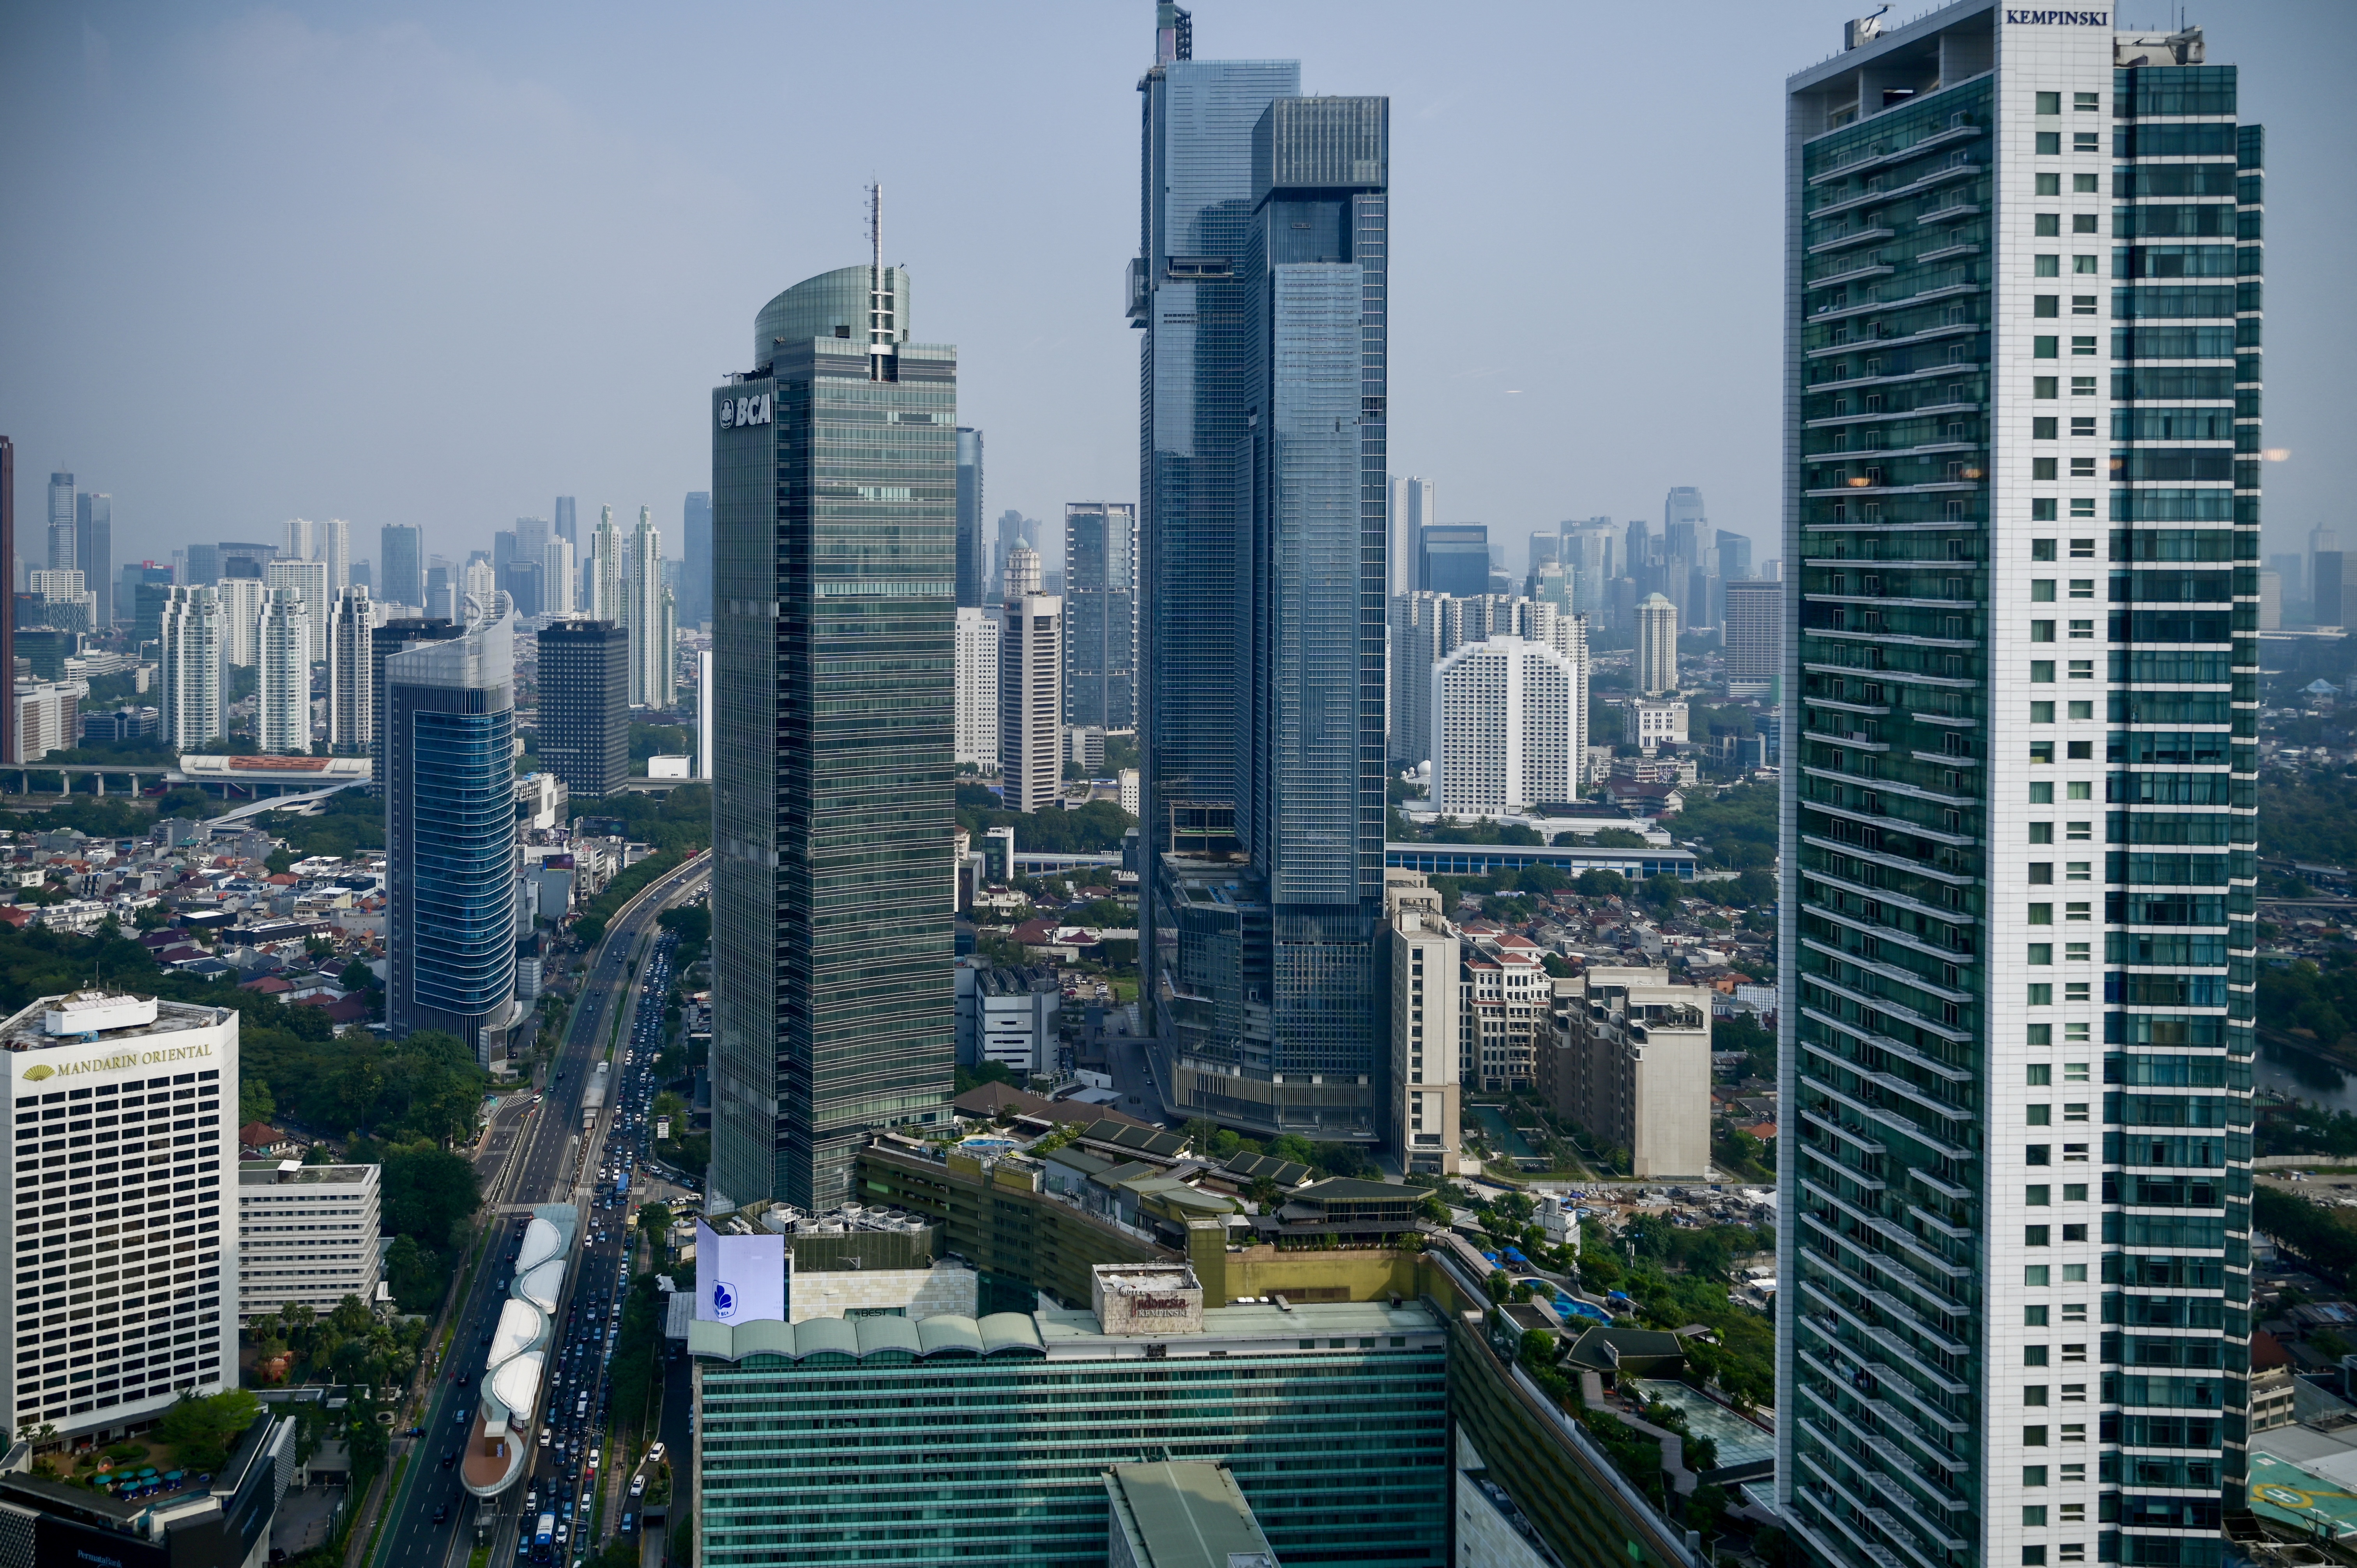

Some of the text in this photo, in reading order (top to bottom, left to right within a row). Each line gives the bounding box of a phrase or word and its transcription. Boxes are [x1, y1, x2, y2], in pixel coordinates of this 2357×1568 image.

[2006, 10, 2108, 26] KEMPINSKI
[736, 394, 770, 426] BCA
[58, 1044, 212, 1076] MANDARIN ORIENTAL
[1132, 1293, 1190, 1317] Indonesia
[1138, 1308, 1189, 1317] KEMPINSKI
[78, 1549, 122, 1568] PermataBank
